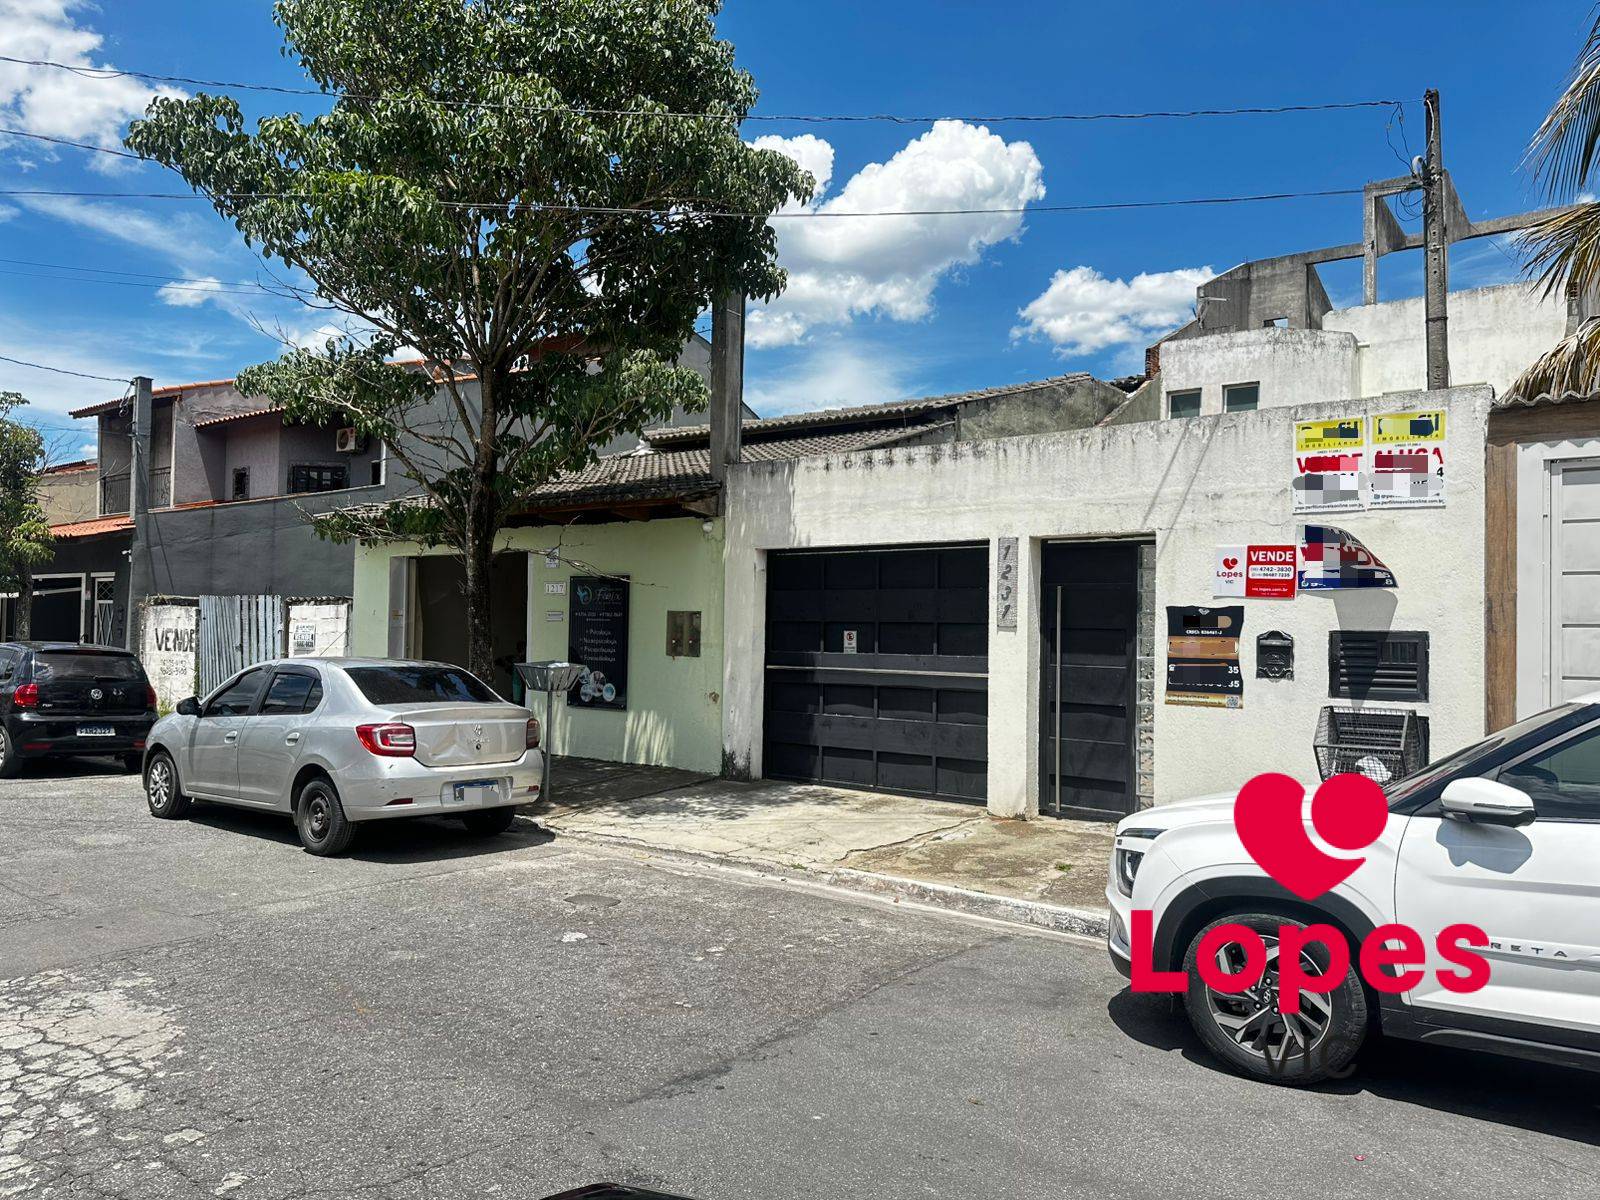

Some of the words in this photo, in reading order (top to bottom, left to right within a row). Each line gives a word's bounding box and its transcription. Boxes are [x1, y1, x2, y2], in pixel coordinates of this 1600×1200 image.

[1250, 550, 1293, 562] VENDE
[1216, 570, 1243, 579] Lopes
[546, 584, 564, 593] 1217
[155, 628, 196, 652] VENDE
[1490, 942, 1568, 958] RETA
